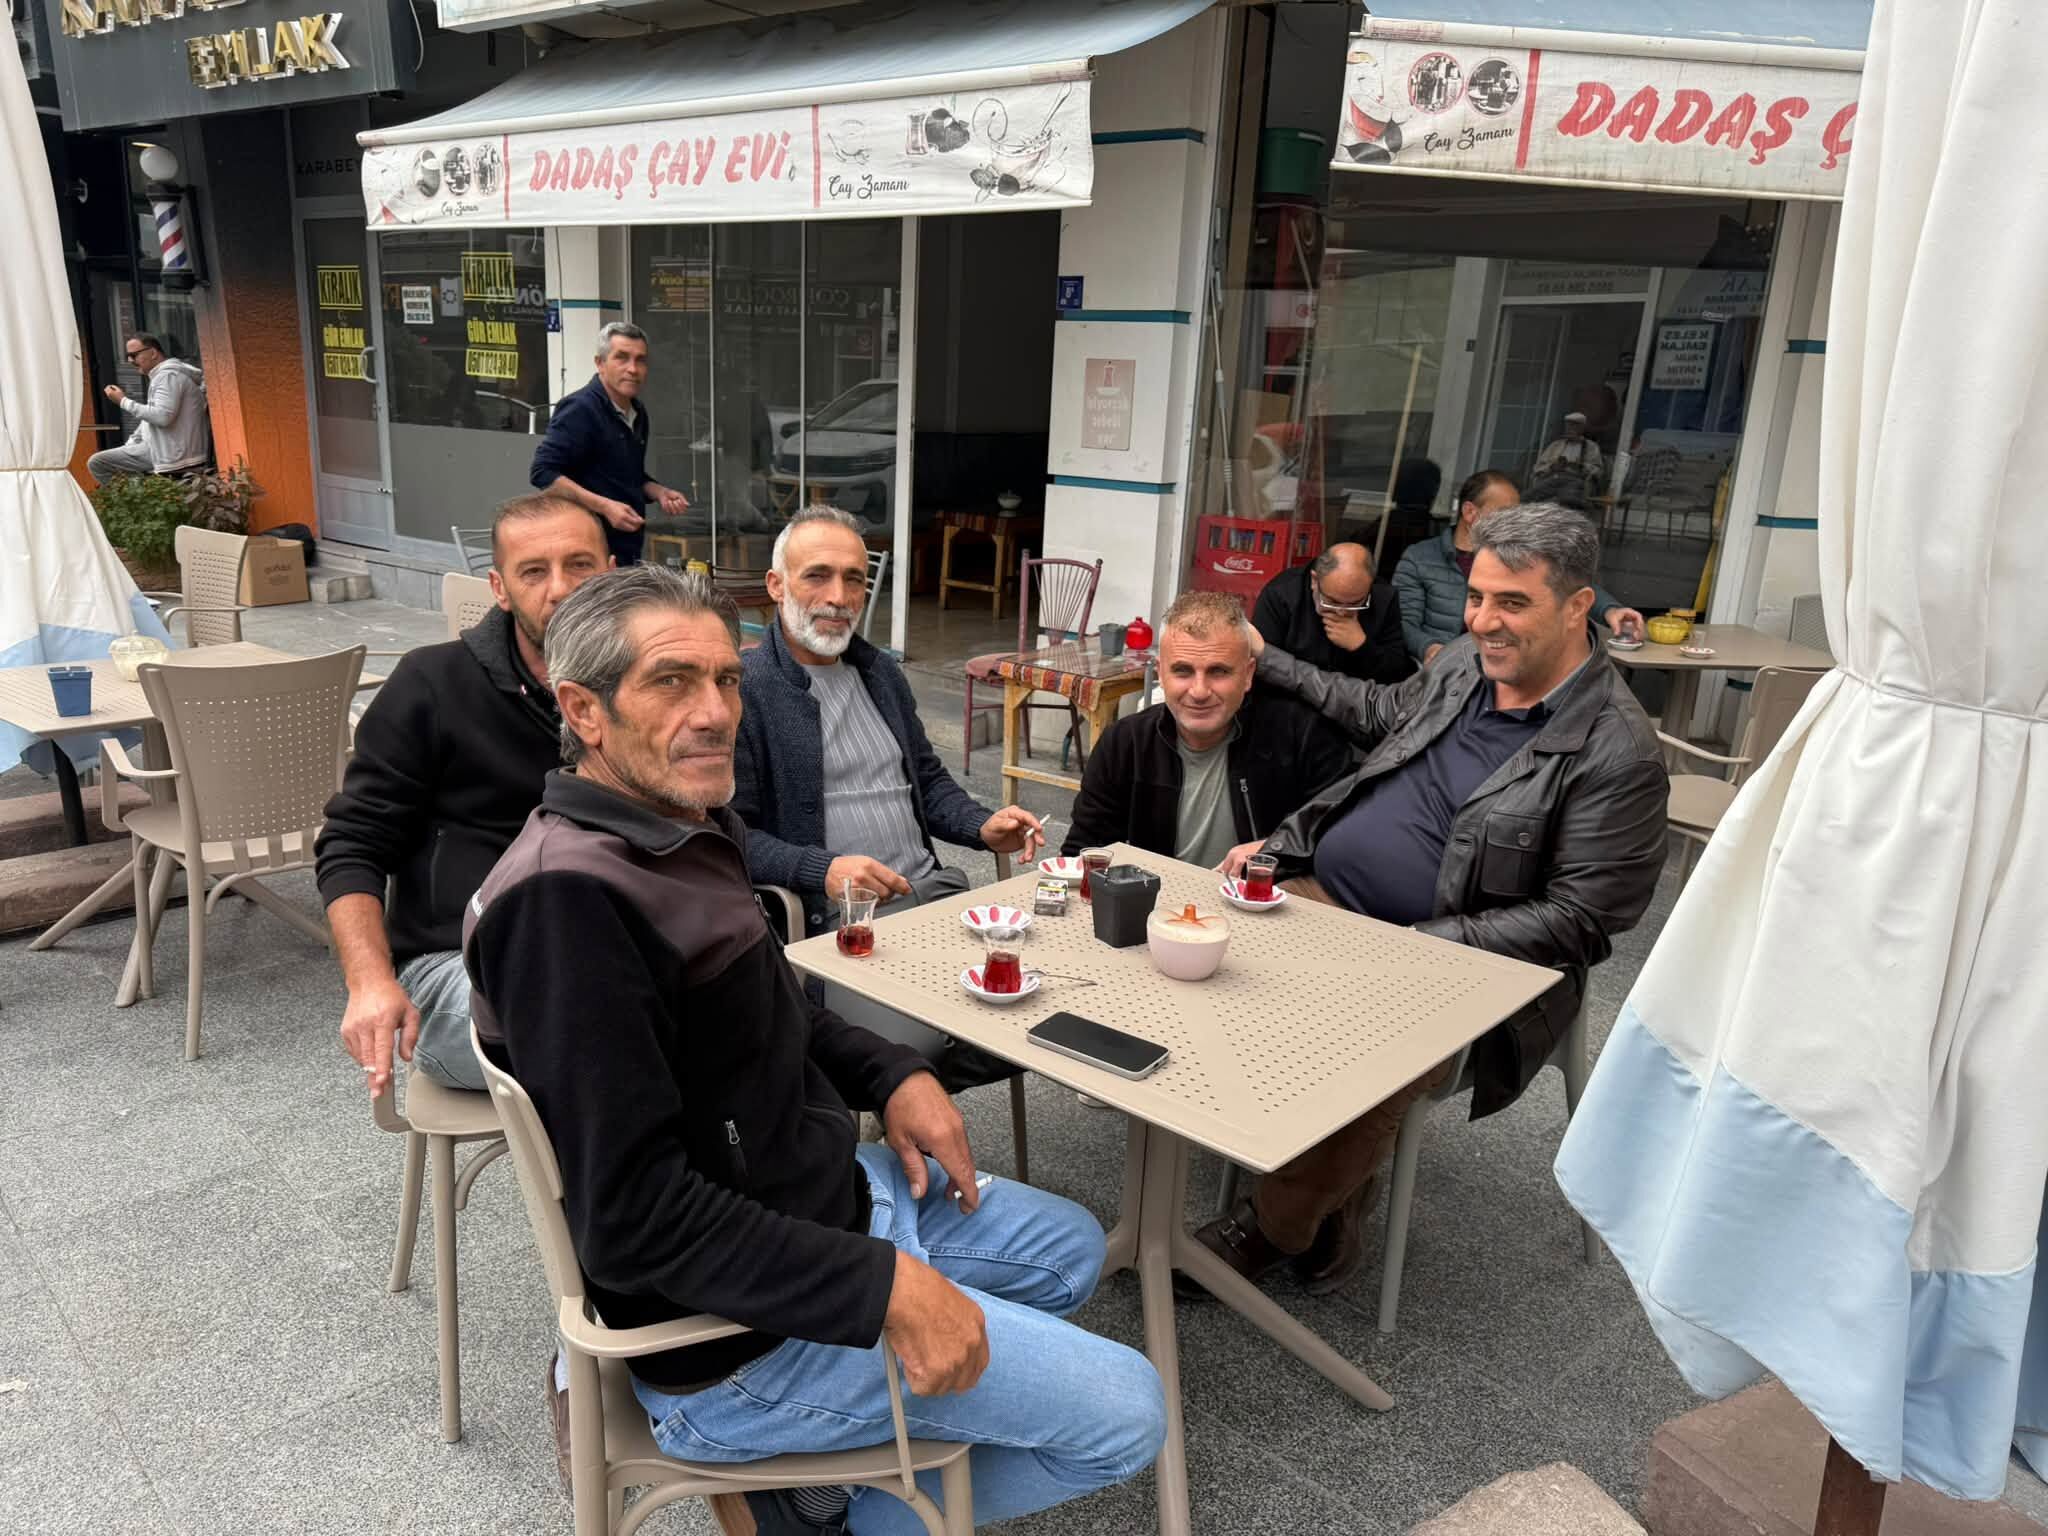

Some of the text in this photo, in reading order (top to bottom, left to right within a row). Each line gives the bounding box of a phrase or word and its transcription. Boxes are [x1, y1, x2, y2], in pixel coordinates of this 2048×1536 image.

[184, 12, 350, 89] EMLAK
[1457, 127, 1514, 150] Zamanı
[1556, 81, 1810, 165] DADAŞ
[529, 143, 639, 200] DADAŞ
[647, 135, 717, 199] ÇAY
[856, 173, 910, 200] Zamanı
[486, 321, 517, 345] EMLAK
